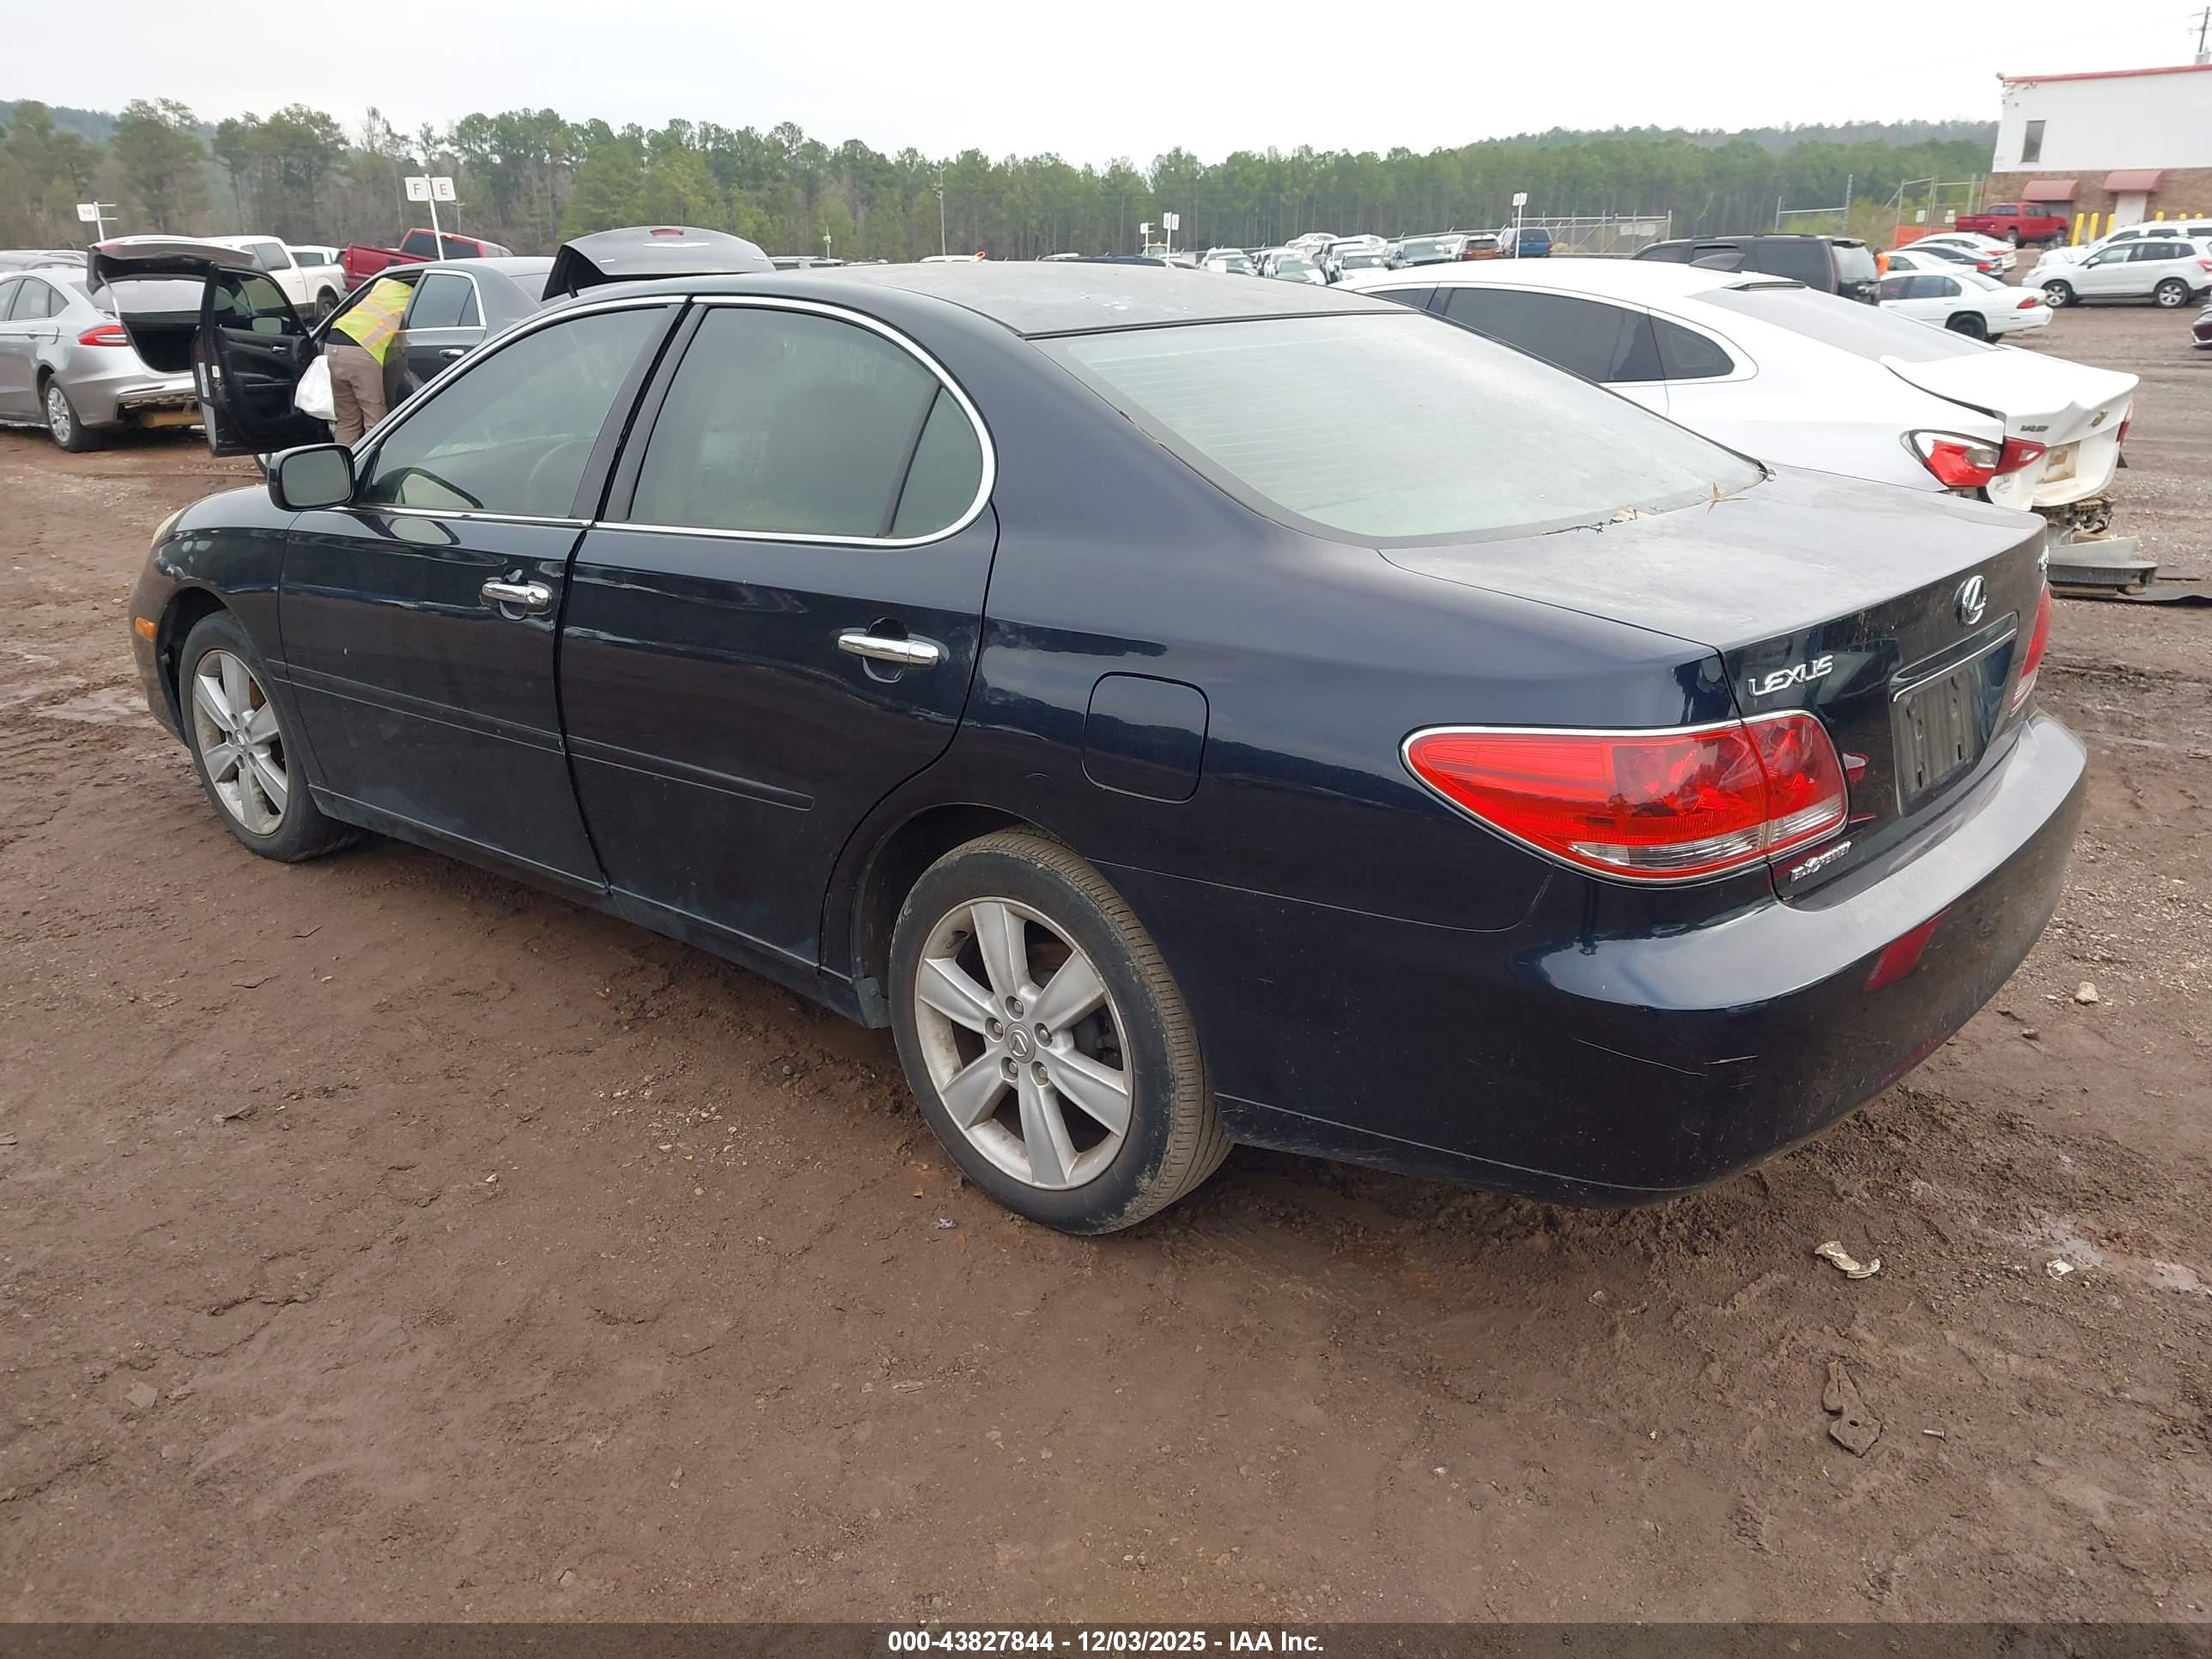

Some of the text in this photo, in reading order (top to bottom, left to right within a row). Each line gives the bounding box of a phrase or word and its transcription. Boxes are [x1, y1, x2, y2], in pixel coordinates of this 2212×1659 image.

[412, 183, 421, 195] F
[439, 183, 448, 196] E
[1747, 654, 1834, 696] LEXUS
